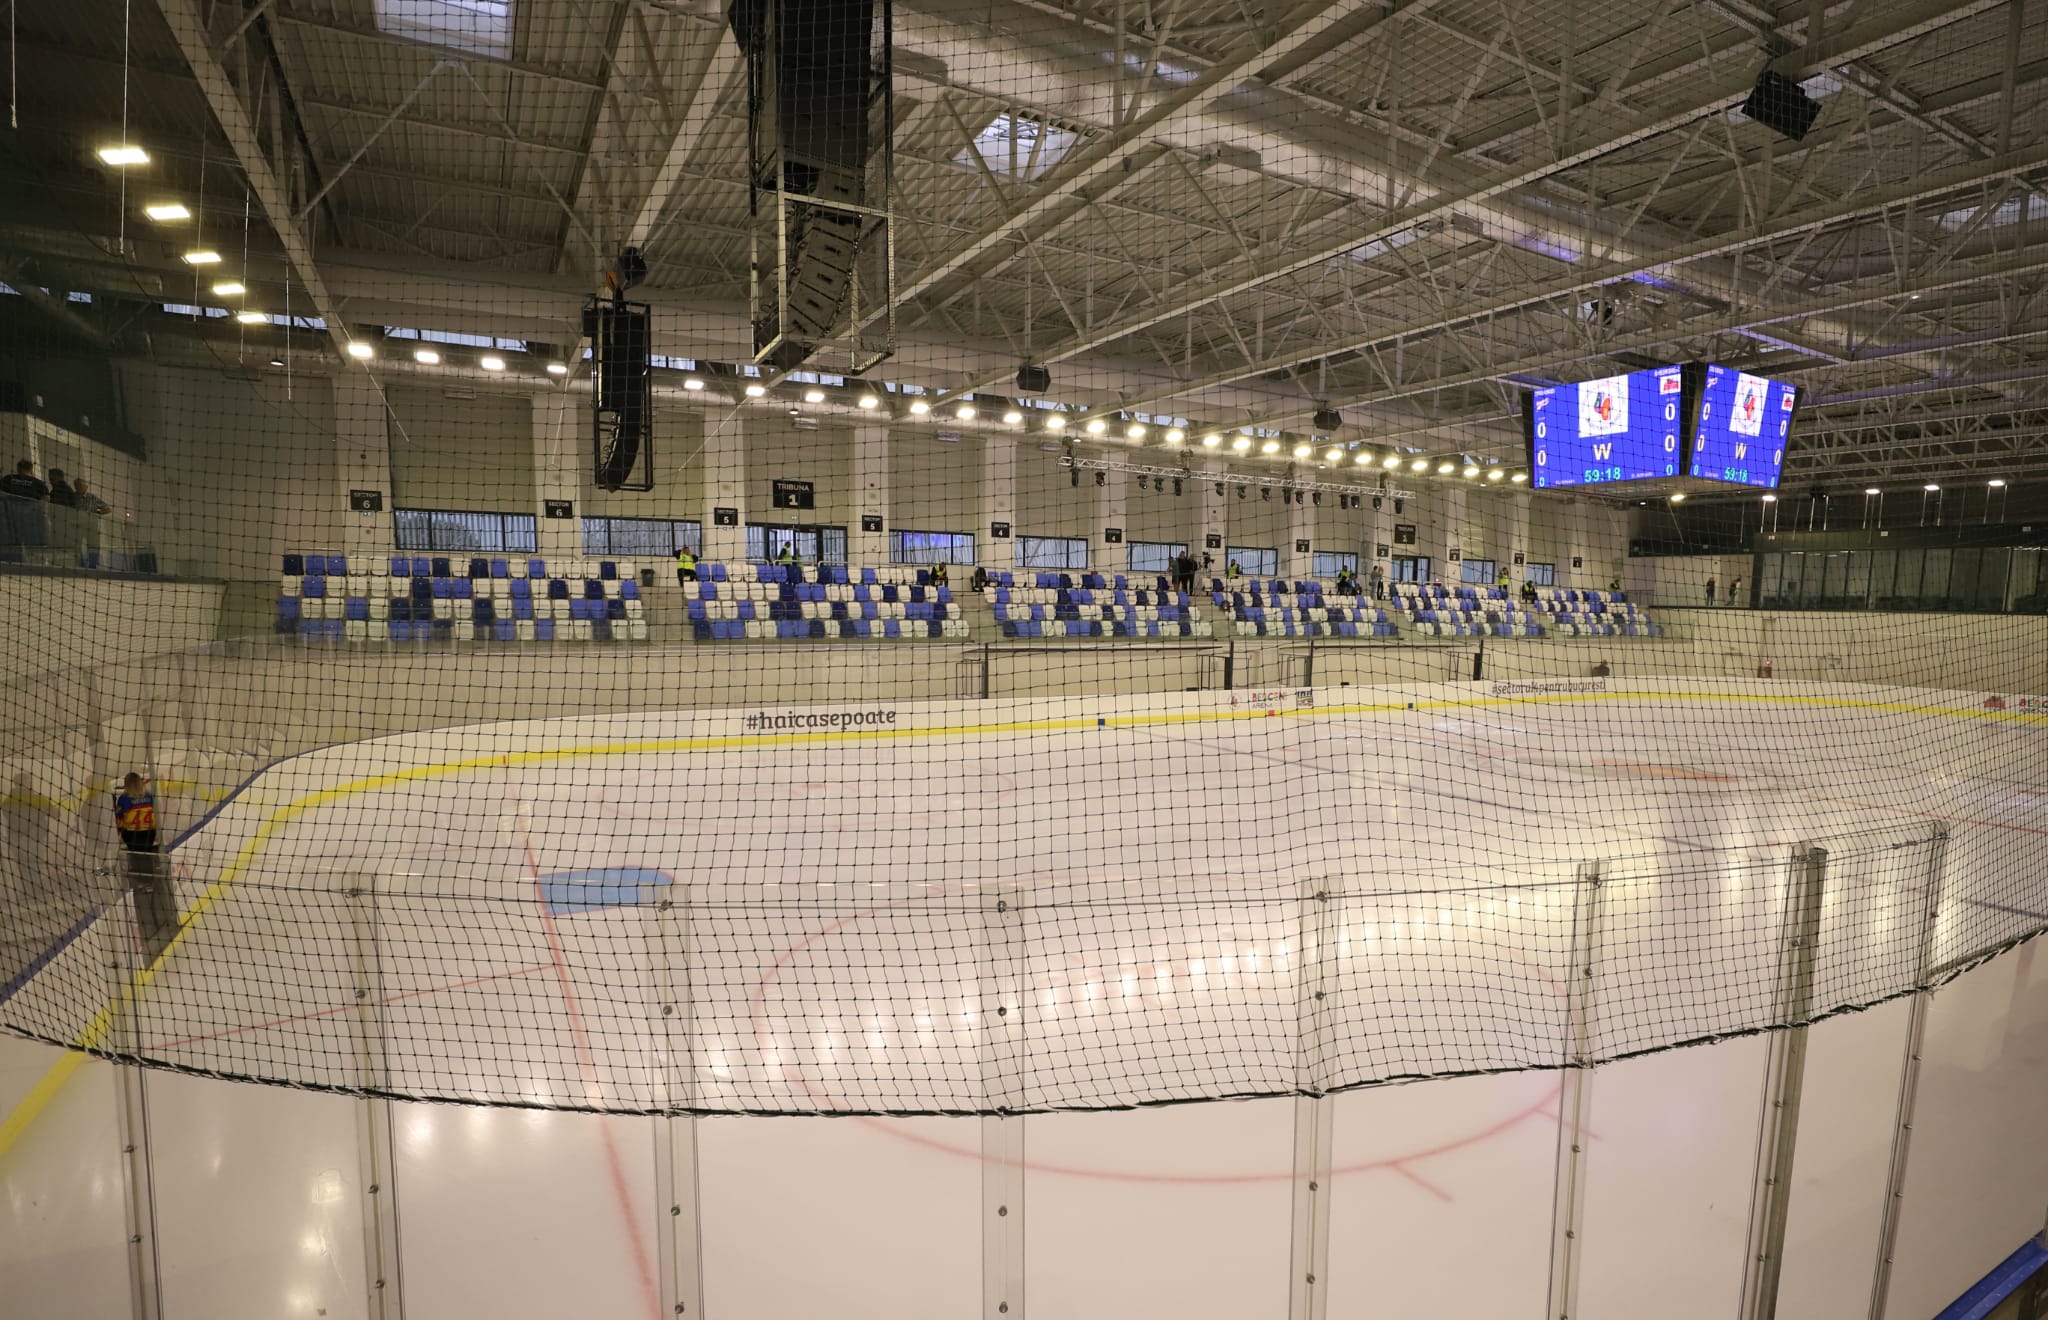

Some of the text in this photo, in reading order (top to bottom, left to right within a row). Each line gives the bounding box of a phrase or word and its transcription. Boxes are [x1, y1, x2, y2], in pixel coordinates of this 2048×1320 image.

[1665, 403, 1676, 421] 0
[1703, 402, 1711, 421] 0
[1537, 422, 1547, 439] 0
[1780, 420, 1788, 437] 0
[1665, 434, 1675, 452] 0
[1697, 434, 1705, 452] 0
[1735, 441, 1747, 461] W
[1537, 450, 1547, 467] 0
[1593, 442, 1612, 461] W
[1774, 449, 1782, 466] 0
[1584, 467, 1621, 483] 59:18
[1666, 464, 1673, 476] 0
[1693, 464, 1699, 476] 0
[1724, 466, 1749, 482] 59:18
[776, 483, 810, 492] TRIBUNA
[1539, 476, 1545, 488] 0
[363, 499, 371, 509] 6
[788, 494, 799, 506] 1
[556, 508, 563, 517] 6
[723, 516, 730, 524] 5
[870, 523, 876, 531] 5
[998, 529, 1003, 537] 4
[746, 710, 896, 731] #haicasepoate
